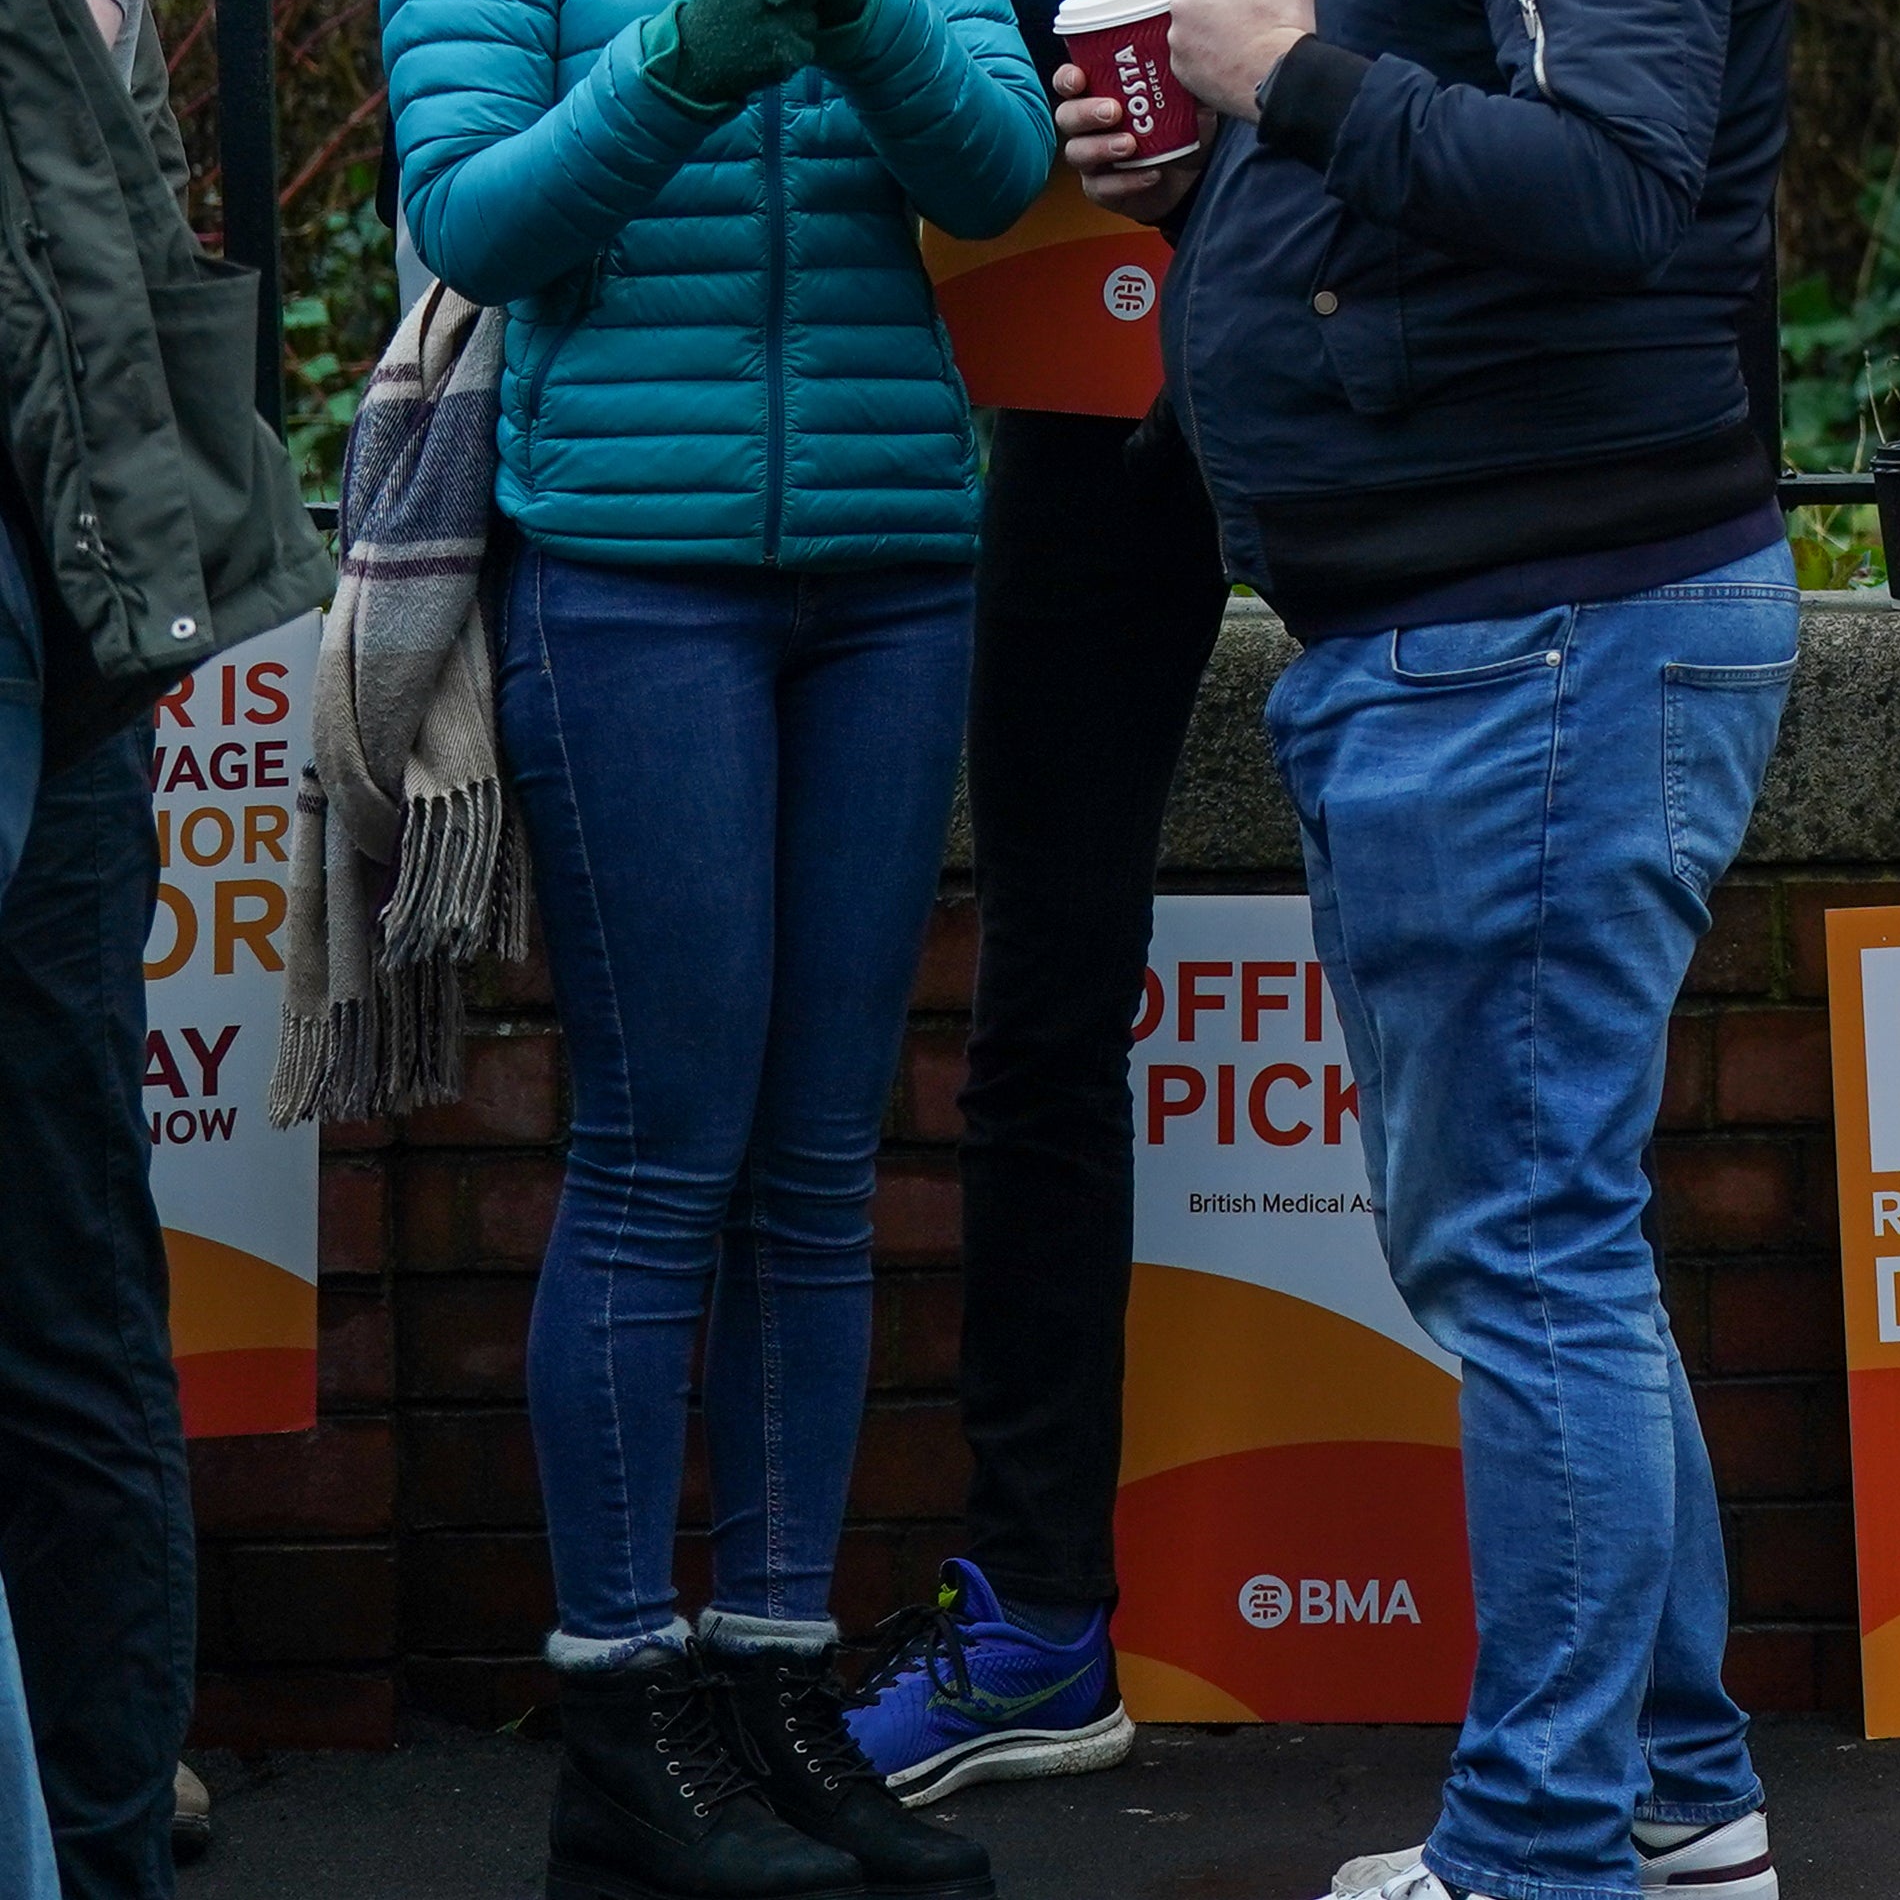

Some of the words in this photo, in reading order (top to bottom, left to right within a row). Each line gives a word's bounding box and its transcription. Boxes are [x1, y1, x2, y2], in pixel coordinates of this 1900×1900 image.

[1114, 44, 1154, 135] COSTA
[1145, 59, 1165, 109] COFFEE
[221, 662, 290, 726] IS
[1148, 1063, 1359, 1146] PICK
[1190, 1194, 1256, 1213] British
[1263, 1194, 1344, 1213] Medical
[1299, 1579, 1421, 1626] BMA
